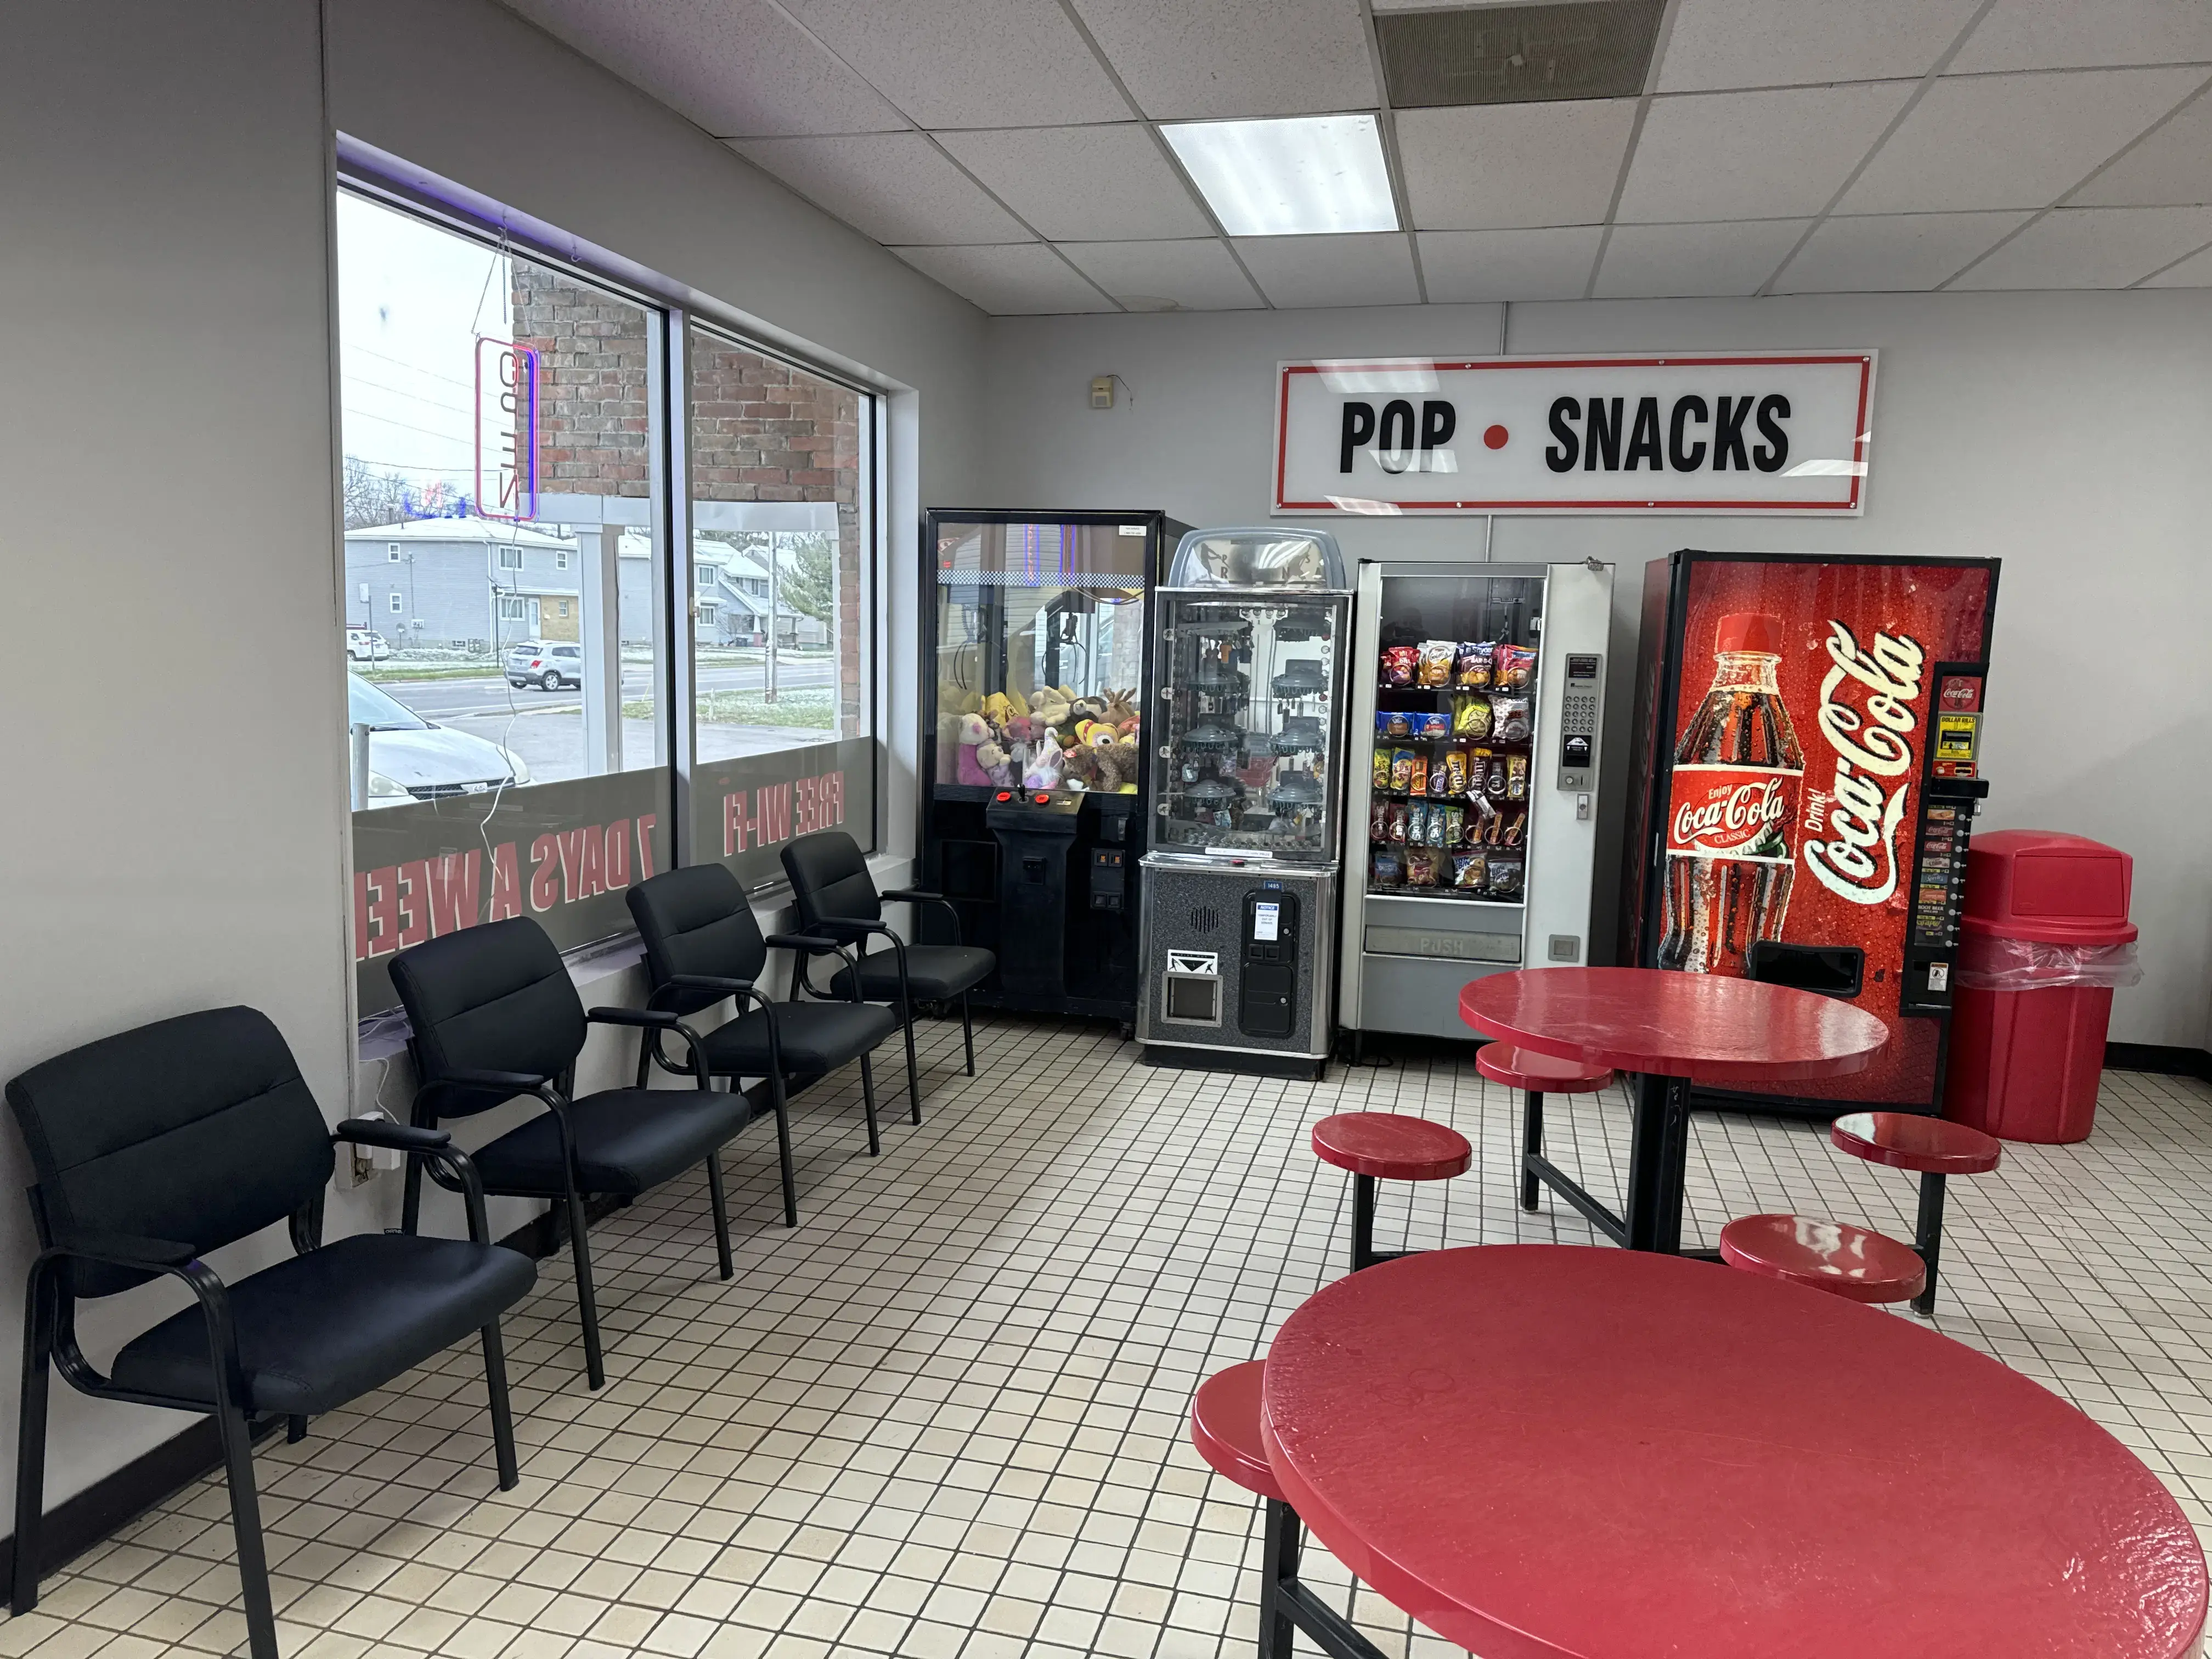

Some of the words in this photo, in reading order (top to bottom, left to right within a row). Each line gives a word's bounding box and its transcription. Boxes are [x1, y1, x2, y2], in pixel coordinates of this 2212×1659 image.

[1339, 399, 1457, 474] POP
[1544, 393, 1792, 473] SNACKS
[1943, 687, 1975, 698] Coca-Cola
[1803, 618, 1926, 905] Coca-Cola
[1708, 783, 1733, 800] Enjoy
[1674, 775, 1785, 845] Coca-Cola
[1805, 788, 1826, 832] Drink!
[1714, 828, 1751, 844] CLASSIC
[1419, 936, 1464, 955] PUSH
